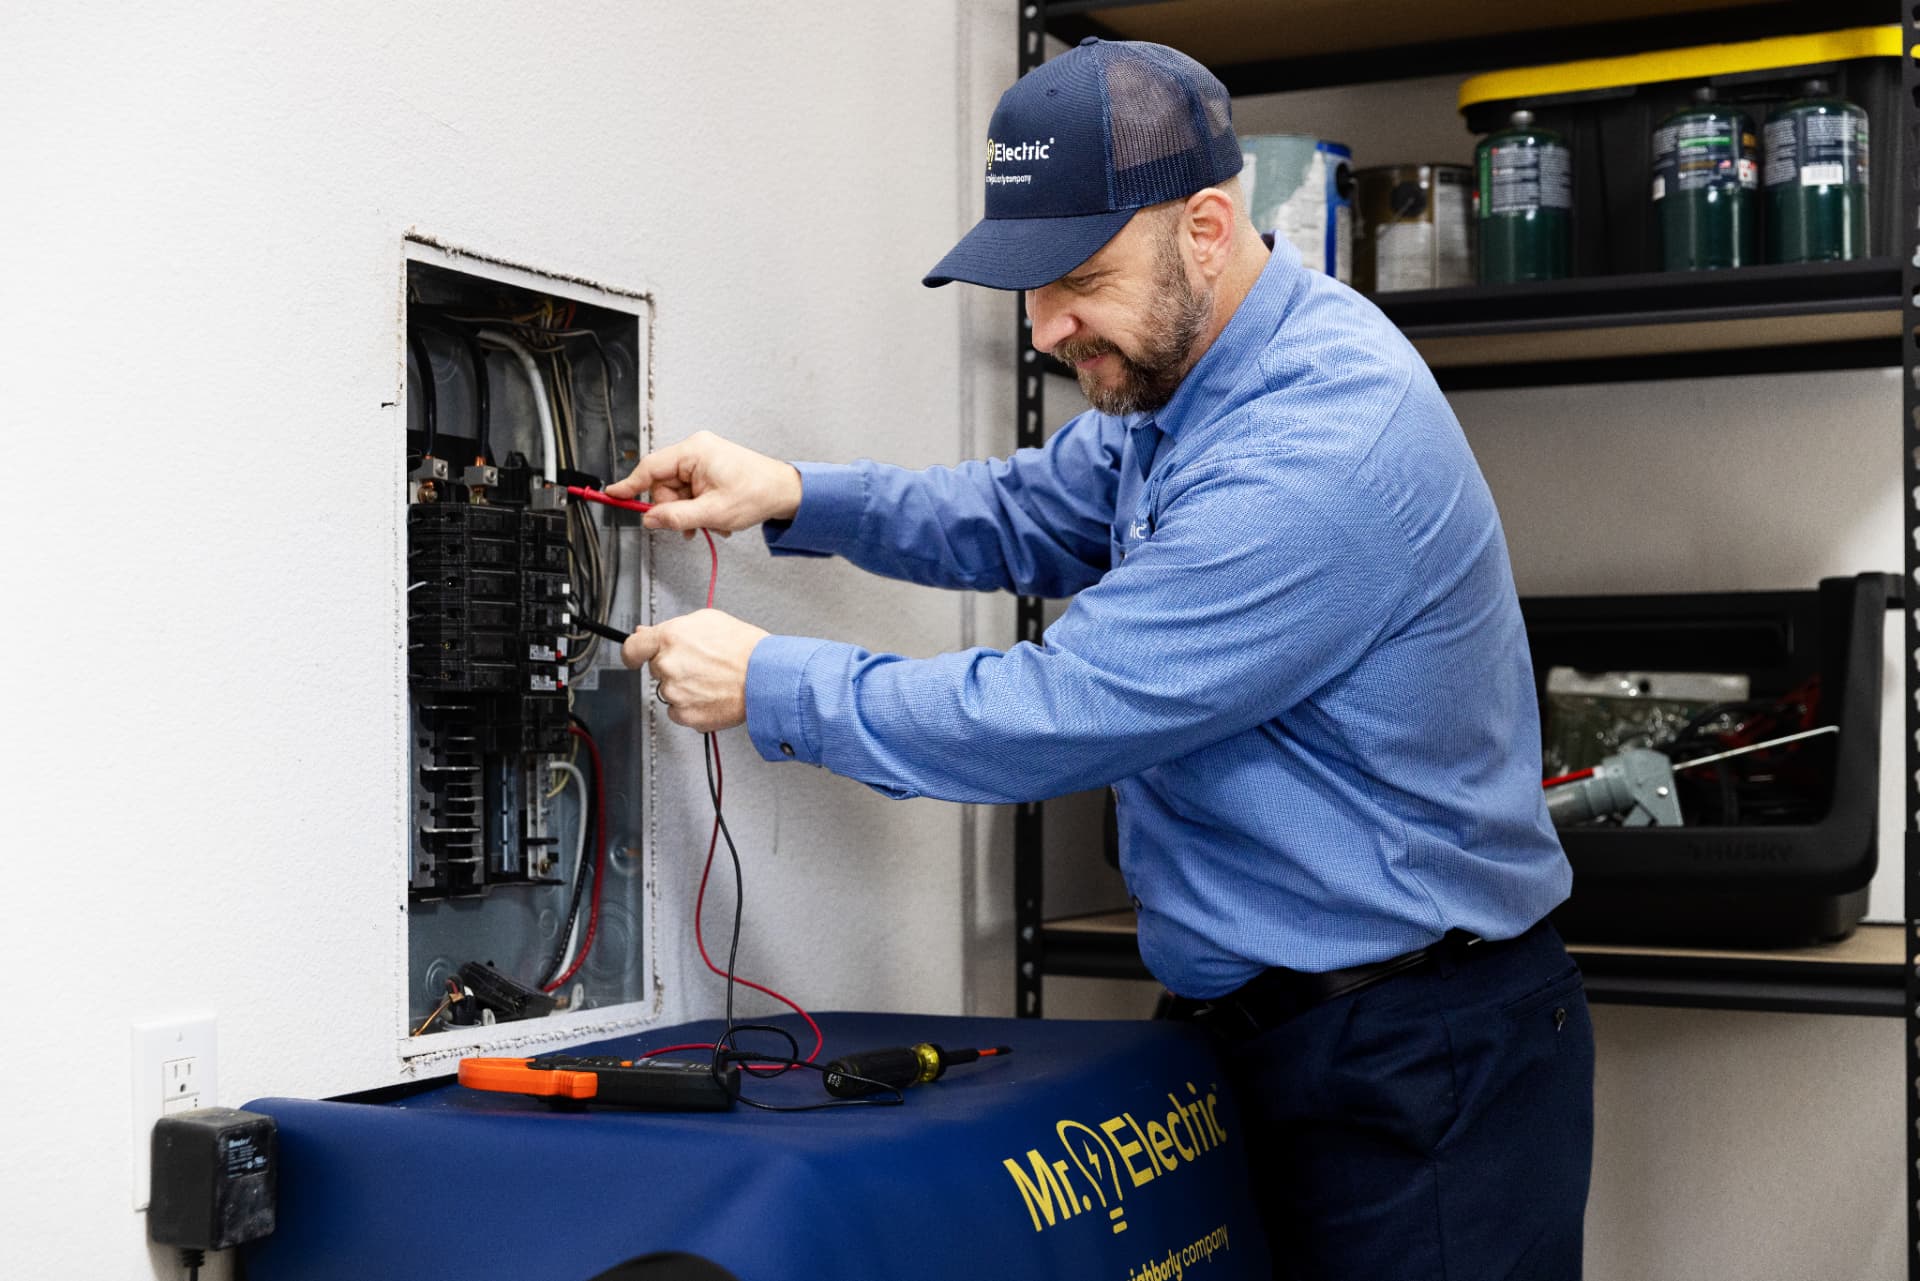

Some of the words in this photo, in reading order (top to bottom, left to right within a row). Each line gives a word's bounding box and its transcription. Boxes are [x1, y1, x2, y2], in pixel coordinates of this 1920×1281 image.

[994, 140, 1050, 162] Electric
[1003, 1149, 1092, 1232] Mr.
[1099, 1081, 1228, 1188] Electric
[1182, 1223, 1230, 1267] company
